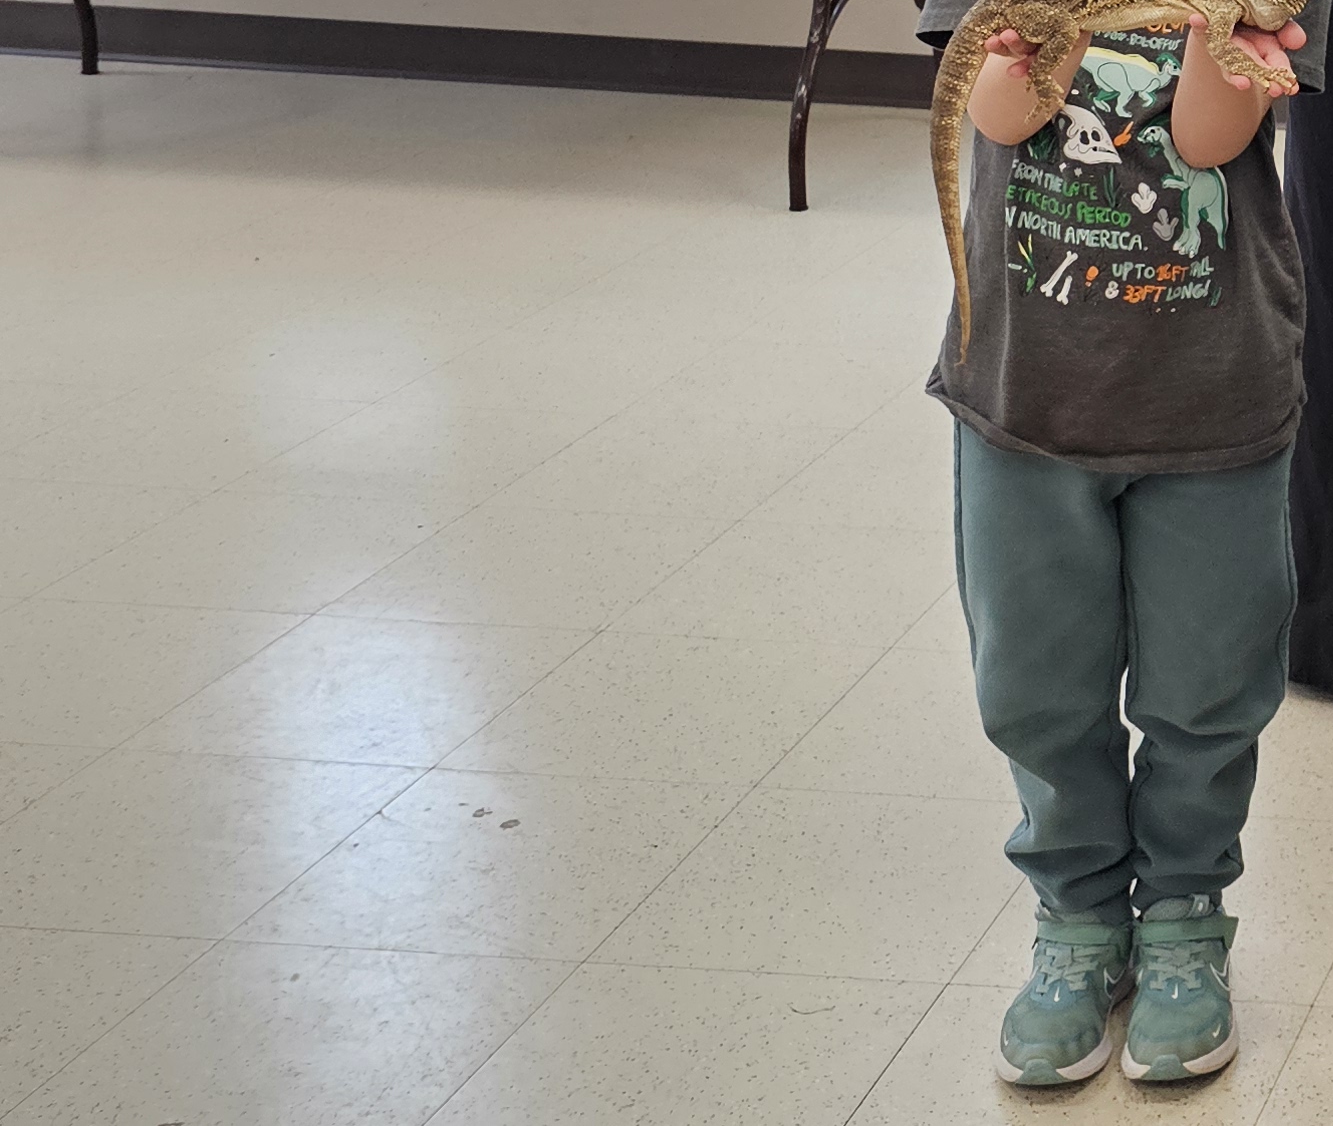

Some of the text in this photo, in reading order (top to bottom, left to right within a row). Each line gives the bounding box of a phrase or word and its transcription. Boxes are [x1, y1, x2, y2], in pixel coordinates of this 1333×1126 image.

[1062, 181, 1098, 201] LATE
[1076, 201, 1131, 228] PERIOD
[1017, 211, 1061, 241] NORTH
[1064, 226, 1149, 252] AMERICA.
[1112, 261, 1134, 281] UP
[1135, 263, 1155, 280] TO
[1105, 280, 1120, 300] &
[1165, 279, 1211, 302] LONG!
